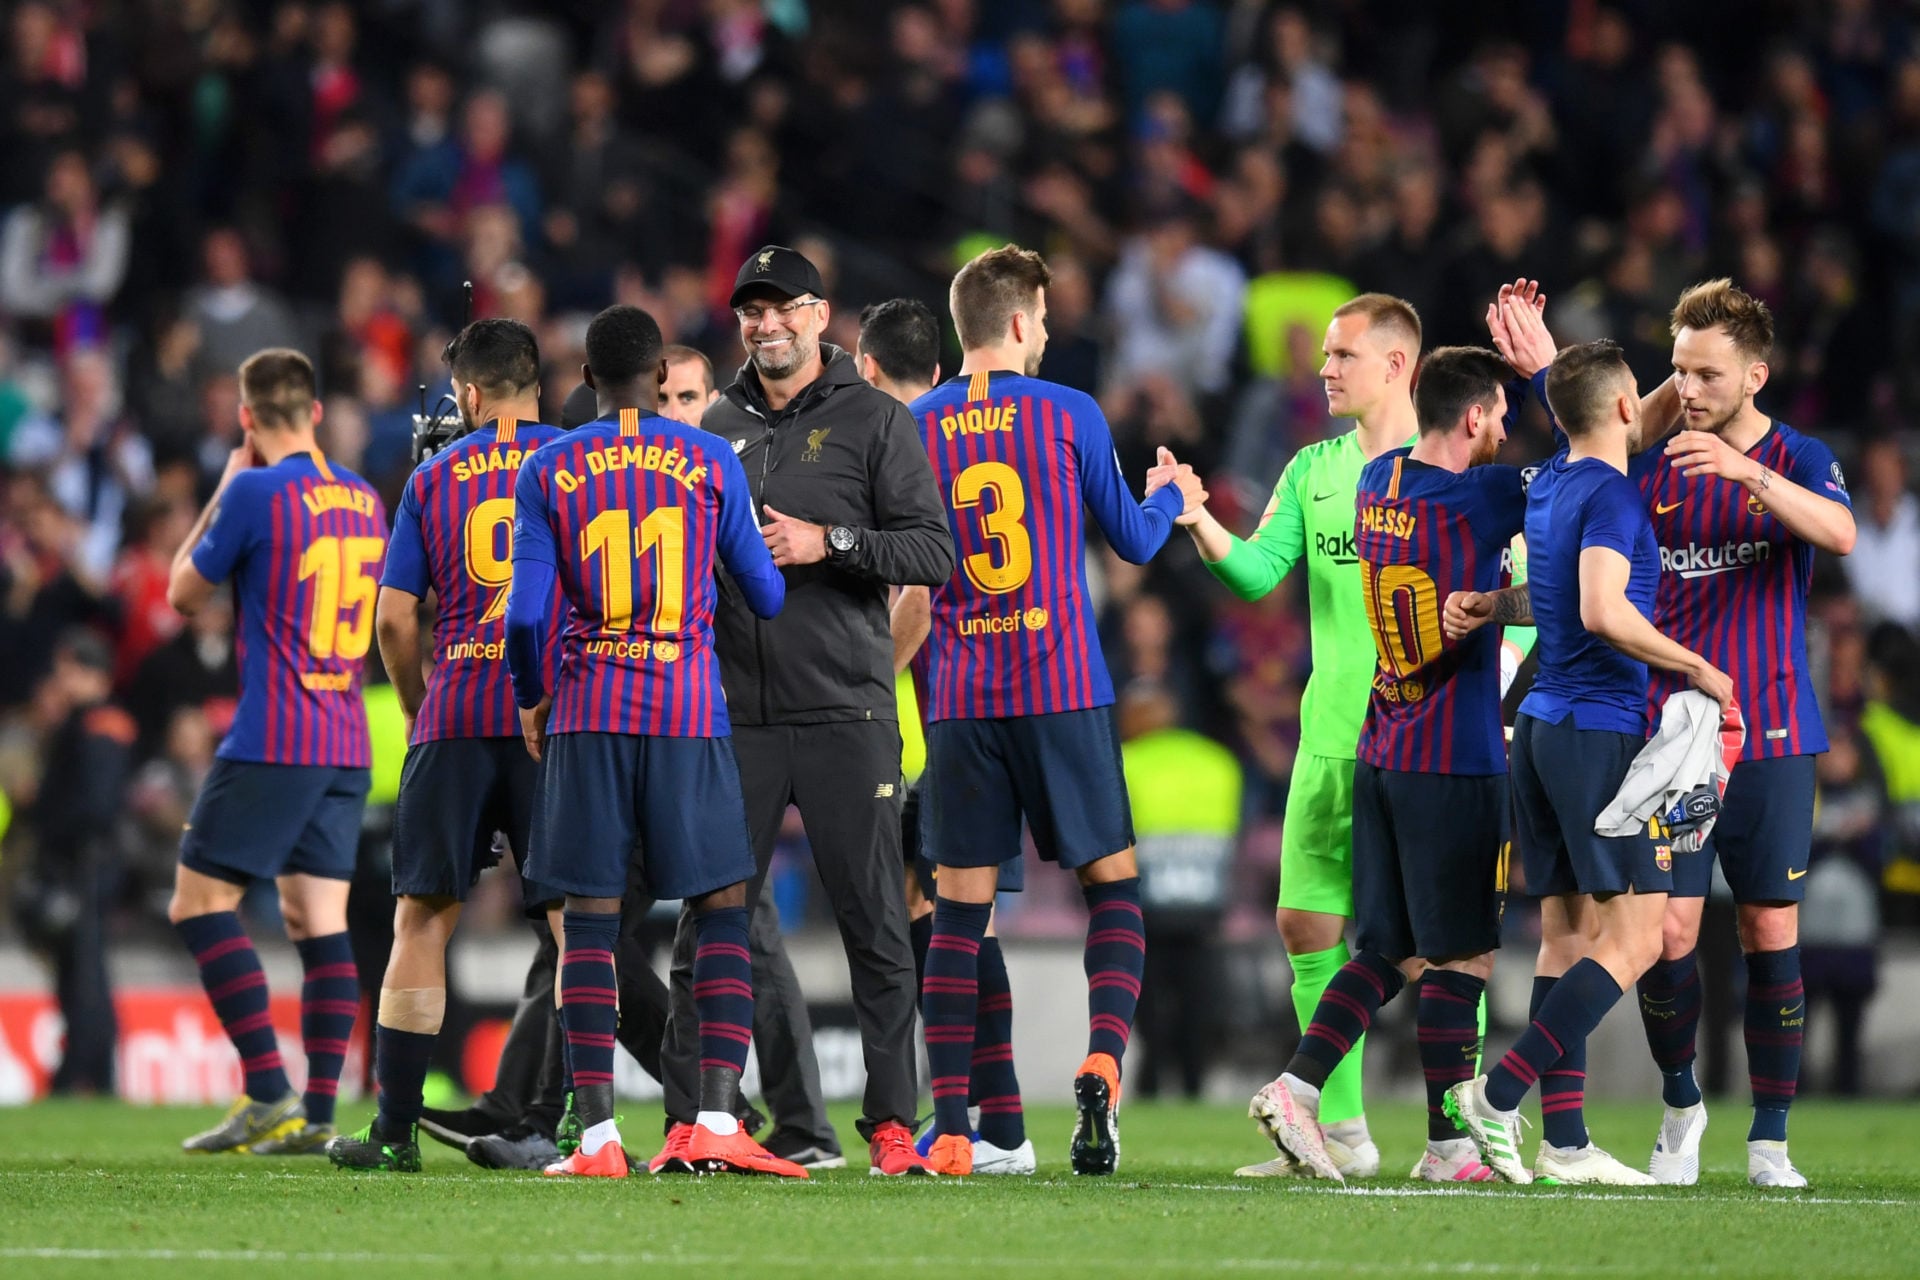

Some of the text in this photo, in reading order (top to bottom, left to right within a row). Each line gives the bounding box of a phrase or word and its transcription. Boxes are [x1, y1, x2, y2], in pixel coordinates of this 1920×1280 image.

[940, 404, 1017, 440] PIQUÉ
[555, 445, 708, 493] O. DEMBÉLÉ
[952, 461, 1032, 594] 3
[1362, 507, 1416, 540] MESSI
[464, 498, 514, 624] 9
[580, 507, 684, 633] 11
[1659, 540, 1770, 572] Rakuten
[298, 536, 385, 659] 15
[959, 609, 1021, 635] unicef
[447, 638, 505, 660] unicef
[586, 637, 651, 660] unicef
